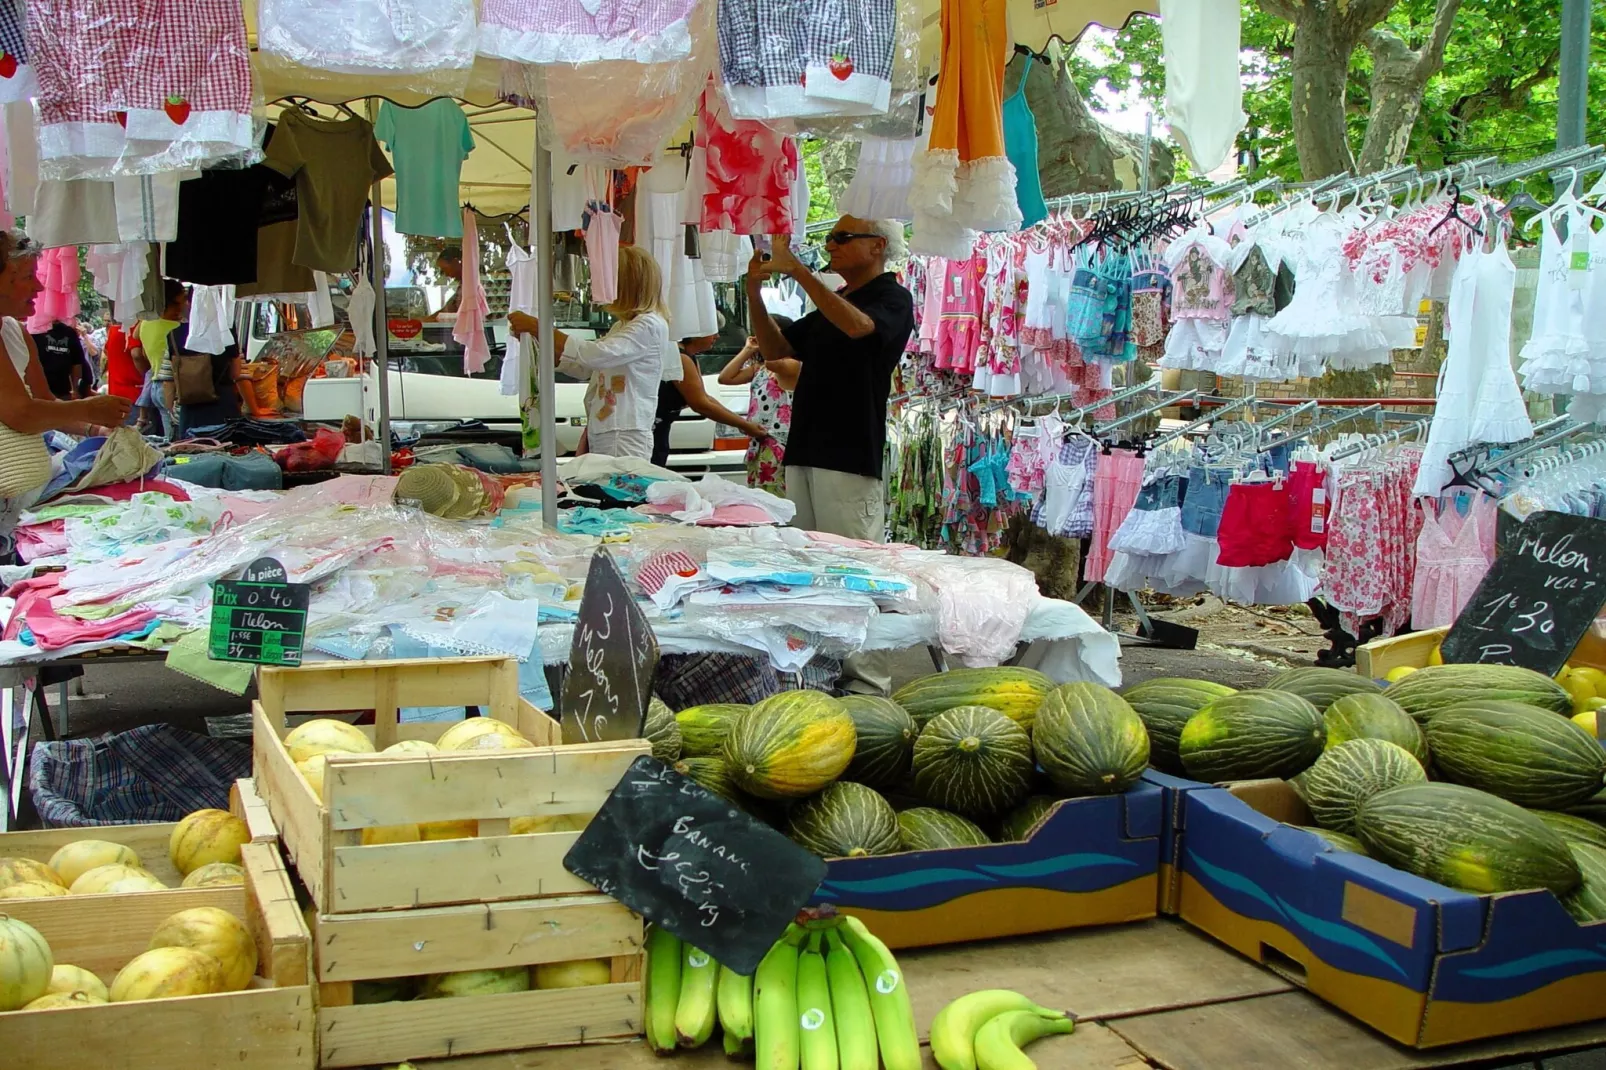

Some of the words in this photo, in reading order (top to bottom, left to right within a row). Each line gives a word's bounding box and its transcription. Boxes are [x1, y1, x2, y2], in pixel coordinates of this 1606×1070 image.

[1518, 533, 1590, 573] Melon
[247, 568, 256, 582] la
[258, 566, 283, 582] pièce
[214, 584, 239, 606] Prix
[241, 611, 289, 631] Melon
